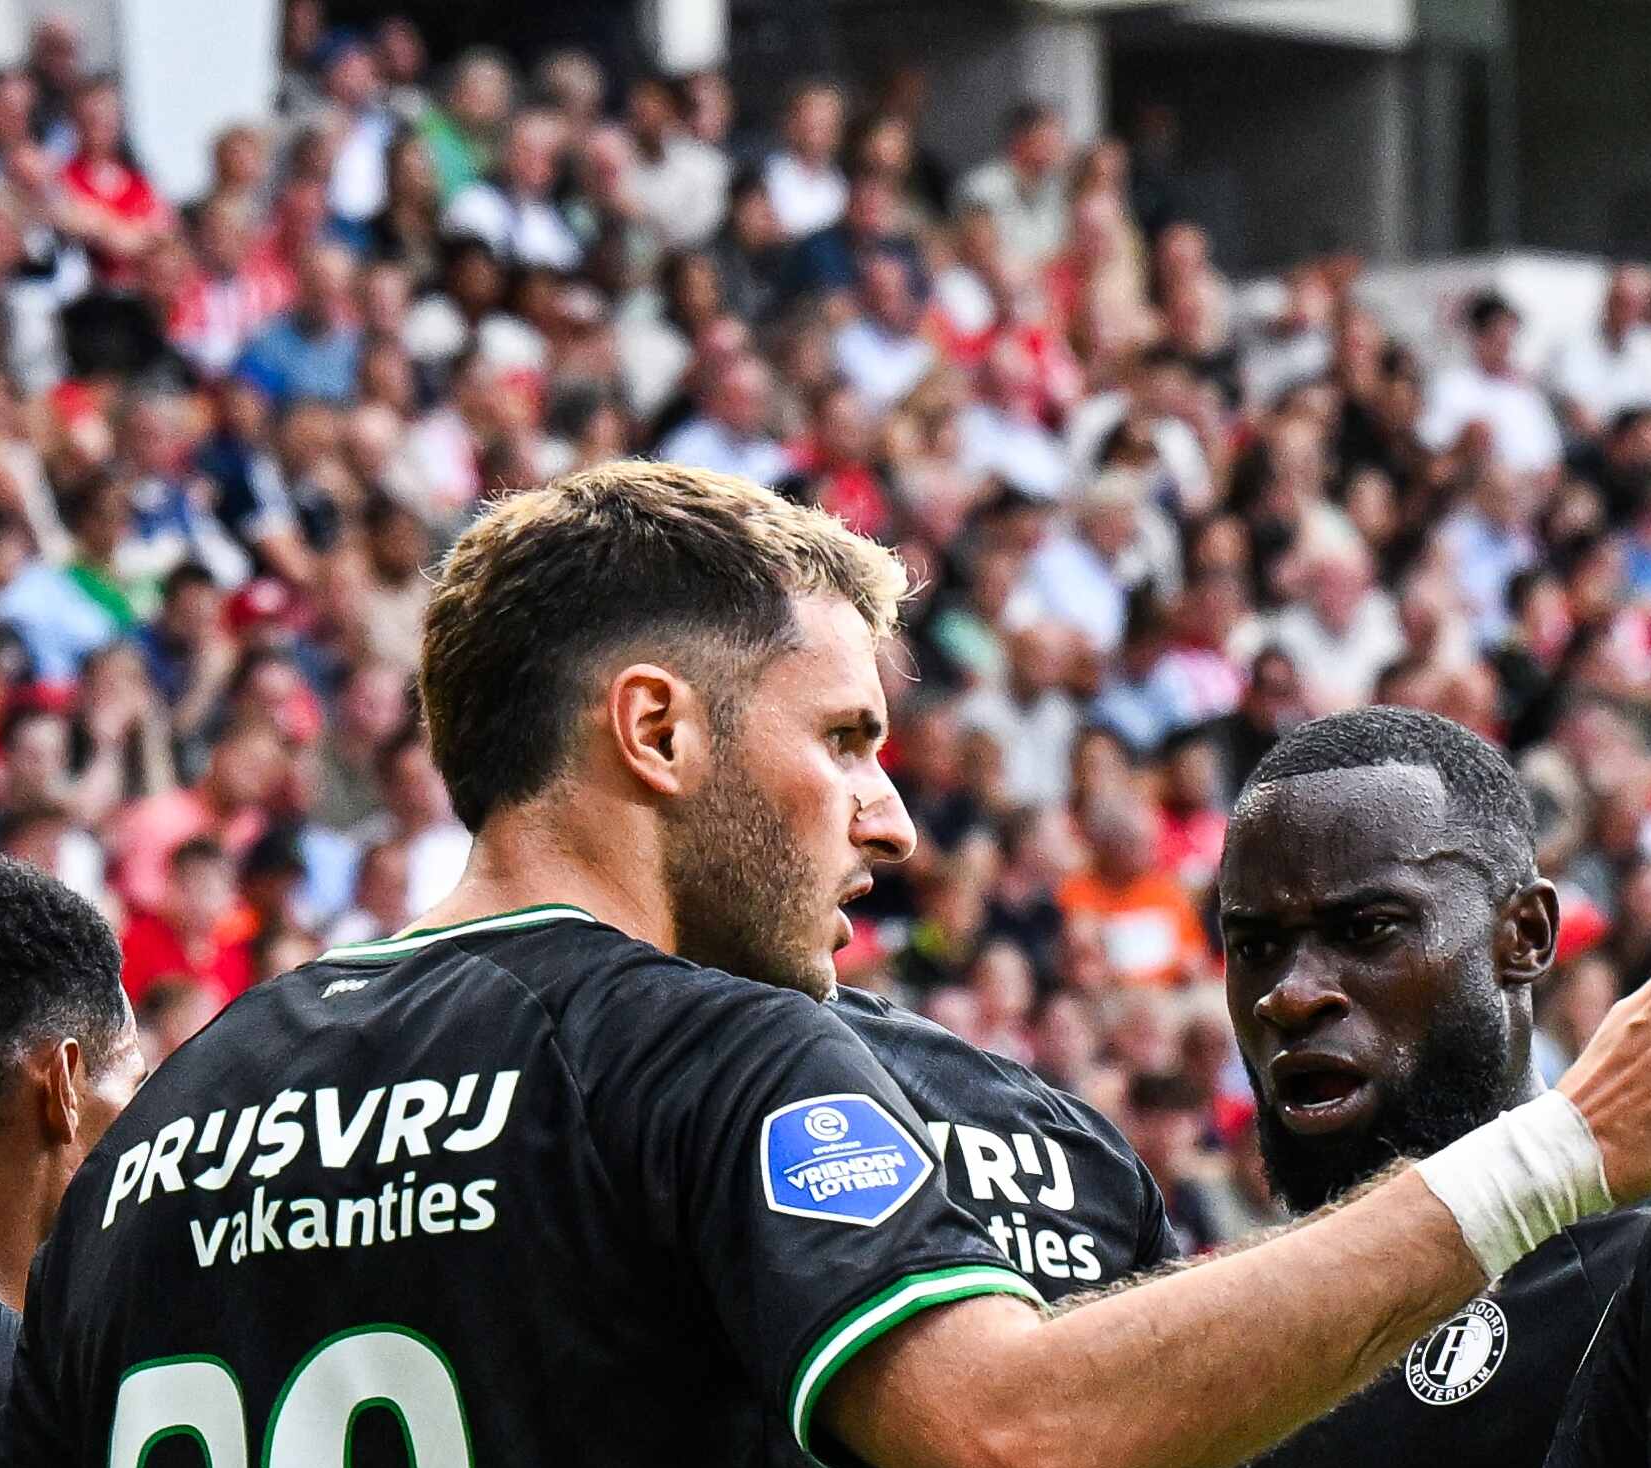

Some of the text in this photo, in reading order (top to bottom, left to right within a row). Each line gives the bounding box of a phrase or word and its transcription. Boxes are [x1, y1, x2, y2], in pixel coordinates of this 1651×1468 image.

[787, 1151, 906, 1190] VRIENDEN
[190, 1174, 497, 1268] vakanties
[1410, 1363, 1492, 1401] ROTTERDAM
